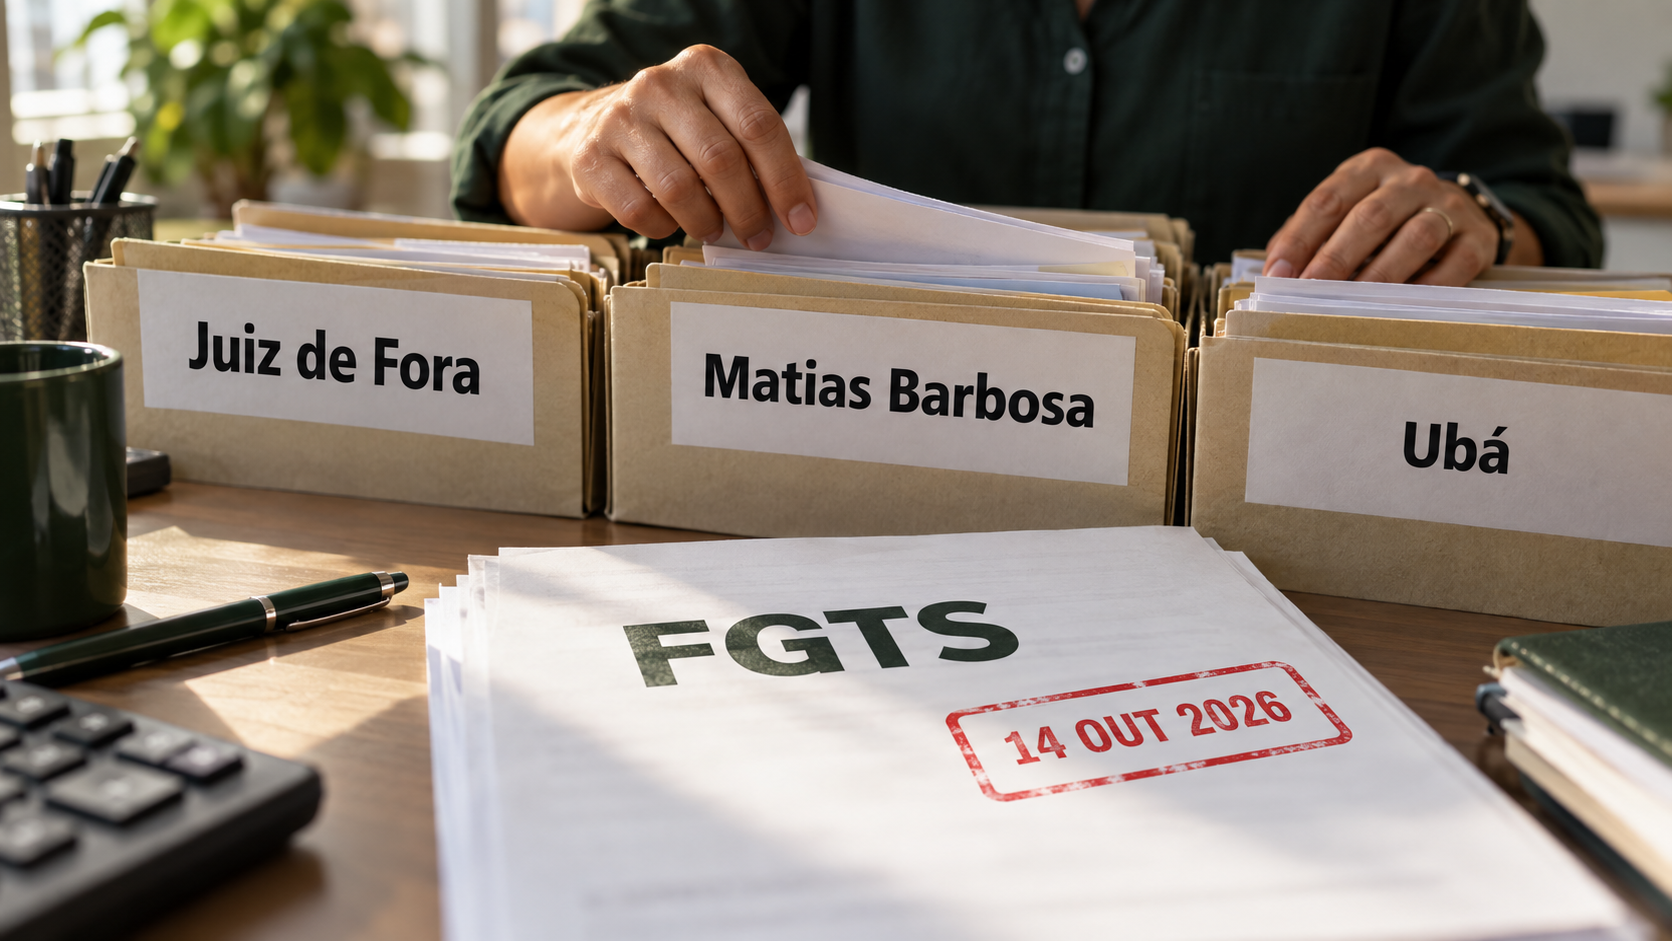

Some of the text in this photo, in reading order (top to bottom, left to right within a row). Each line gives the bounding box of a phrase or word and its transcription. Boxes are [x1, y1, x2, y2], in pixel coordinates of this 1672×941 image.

[188, 320, 481, 396] Juiz de Fora
[704, 352, 1095, 429] Matias Barbosa
[1403, 420, 1511, 475] Ubá
[623, 599, 1021, 687] FGTS
[1003, 690, 1293, 767] 14 OUT 2026
